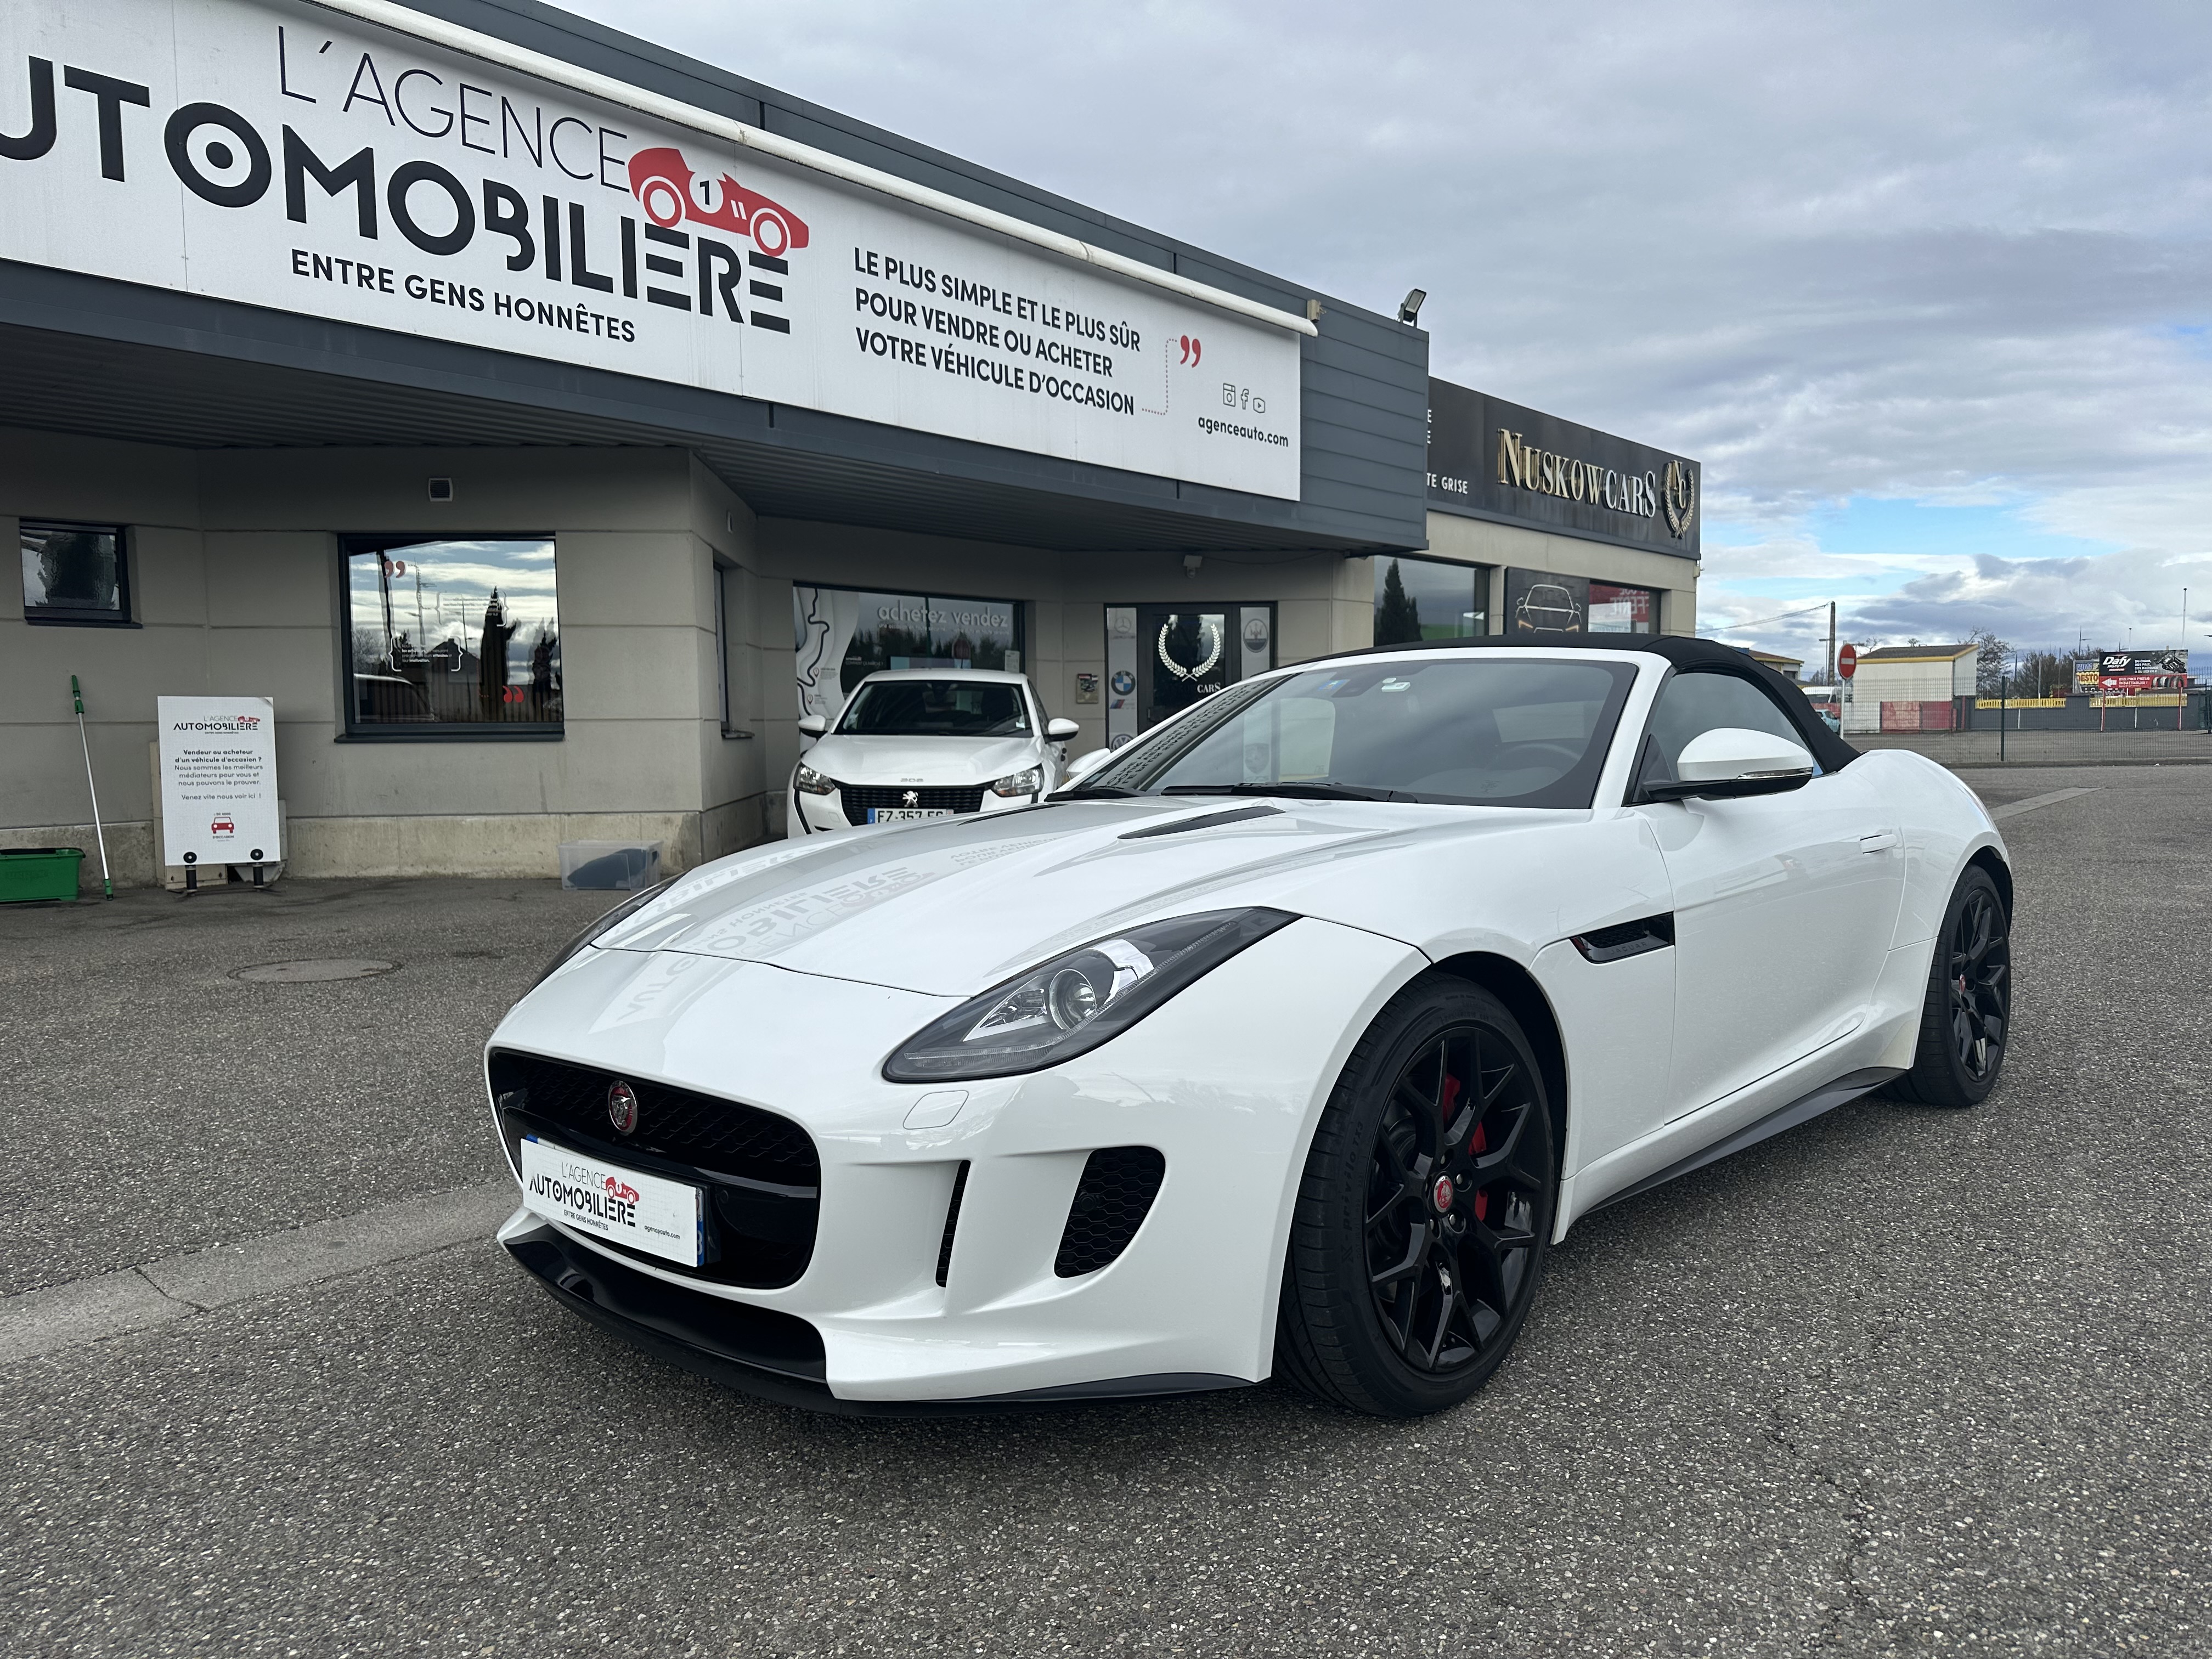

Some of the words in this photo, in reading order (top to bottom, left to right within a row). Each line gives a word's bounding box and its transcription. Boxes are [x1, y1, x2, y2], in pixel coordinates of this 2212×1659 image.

[278, 26, 630, 193] L'AGENCE
[291, 249, 395, 294] ENTRE
[405, 274, 484, 312] GENS
[494, 292, 635, 342] HONNÊTES
[854, 247, 879, 276] LE
[884, 256, 936, 293] PLUS
[941, 274, 1012, 315] SIMPLE
[1017, 296, 1038, 322] ET
[1042, 303, 1061, 330] LE
[1066, 312, 1105, 342] PLUS
[1110, 320, 1141, 352] SÛR
[855, 287, 917, 327] POUR
[922, 305, 999, 348] VENDRE
[1004, 329, 1031, 356] OU
[1035, 338, 1113, 377] ACHETER
[855, 326, 927, 368] VOTRE
[930, 343, 1024, 391] VÉHICULE
[1029, 372, 1134, 416] D'OCCASION
[1198, 416, 1289, 448] agenceauto.com
[1441, 476, 1468, 494] GRISE
[877, 599, 947, 623] achetez
[951, 605, 1008, 628] vendez
[2102, 656, 2131, 667] Dafy
[1197, 682, 1221, 693] CARS
[173, 722, 258, 731] AUTOMOBILIERE
[561, 1161, 607, 1190] L'AGENCE
[529, 1173, 636, 1228] AUTOMOBILIERE
[563, 1209, 575, 1220] ENTRE
[575, 1213, 586, 1223] GENS
[586, 1217, 608, 1231] HONNÊTES
[644, 1224, 681, 1240] agenceauto.com
